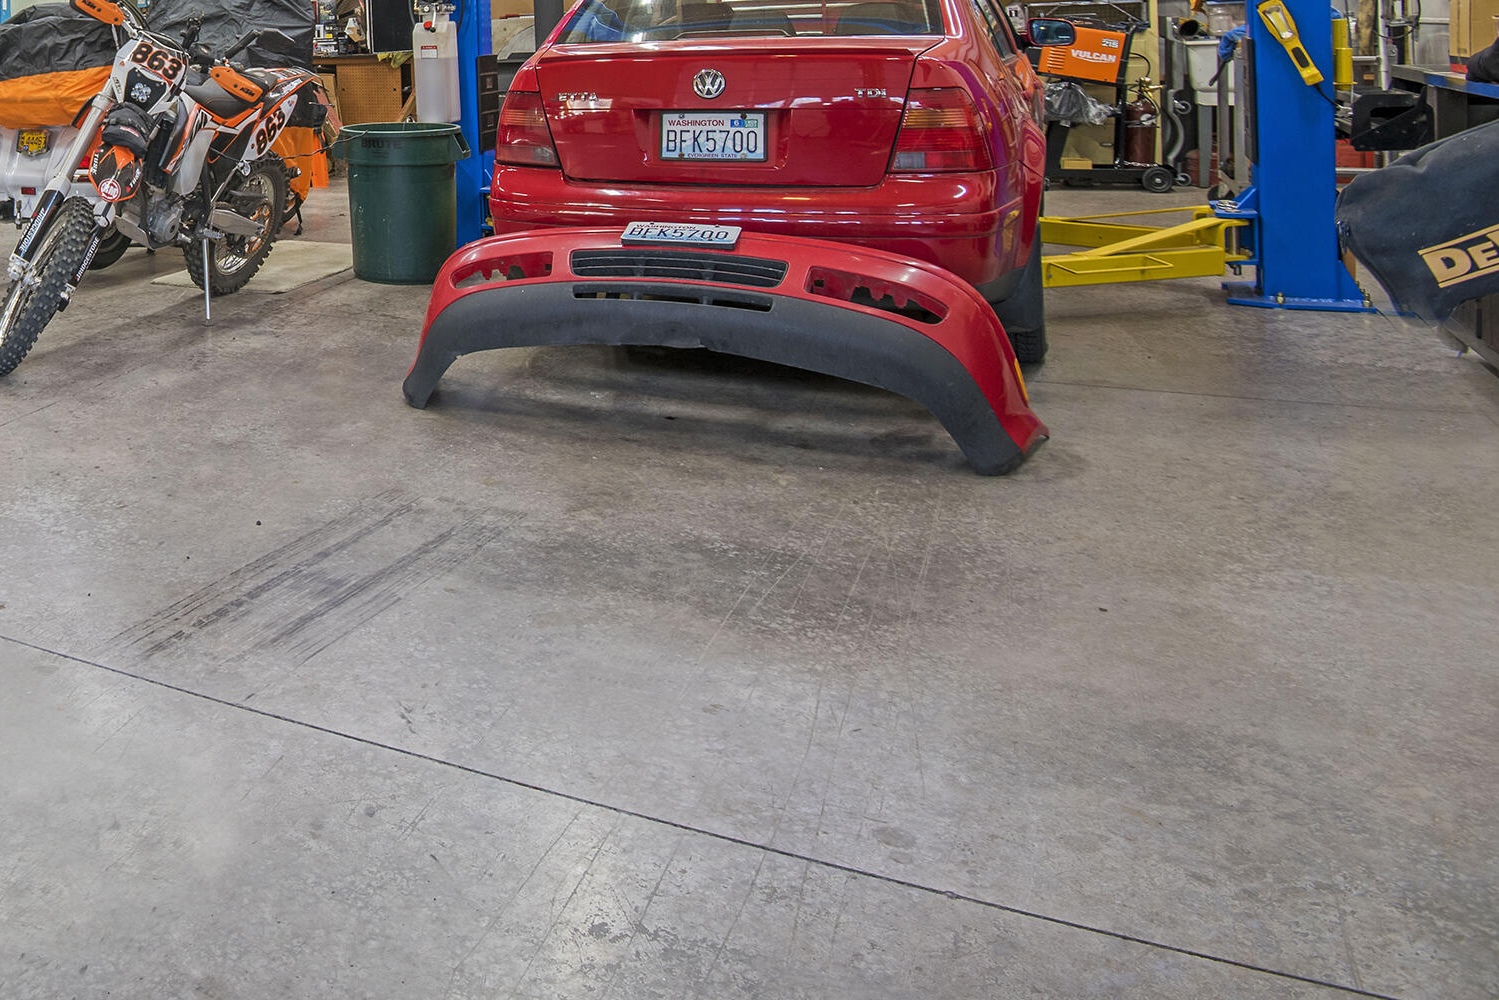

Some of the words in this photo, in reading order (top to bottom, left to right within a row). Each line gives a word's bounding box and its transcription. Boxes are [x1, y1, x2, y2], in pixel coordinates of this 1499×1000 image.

[131, 42, 183, 81] 863
[1070, 48, 1117, 63] VULCAN
[240, 87, 255, 97] KTM
[854, 88, 887, 98] TDI
[256, 106, 286, 155] 863
[668, 119, 725, 127] WASHINGTON
[361, 137, 403, 150] BRUTE
[666, 130, 758, 153] BFK5700
[18, 207, 47, 252] BRIDGESTONE
[628, 227, 730, 240] BFK5700
[75, 235, 101, 282] BRIDGESTONE
